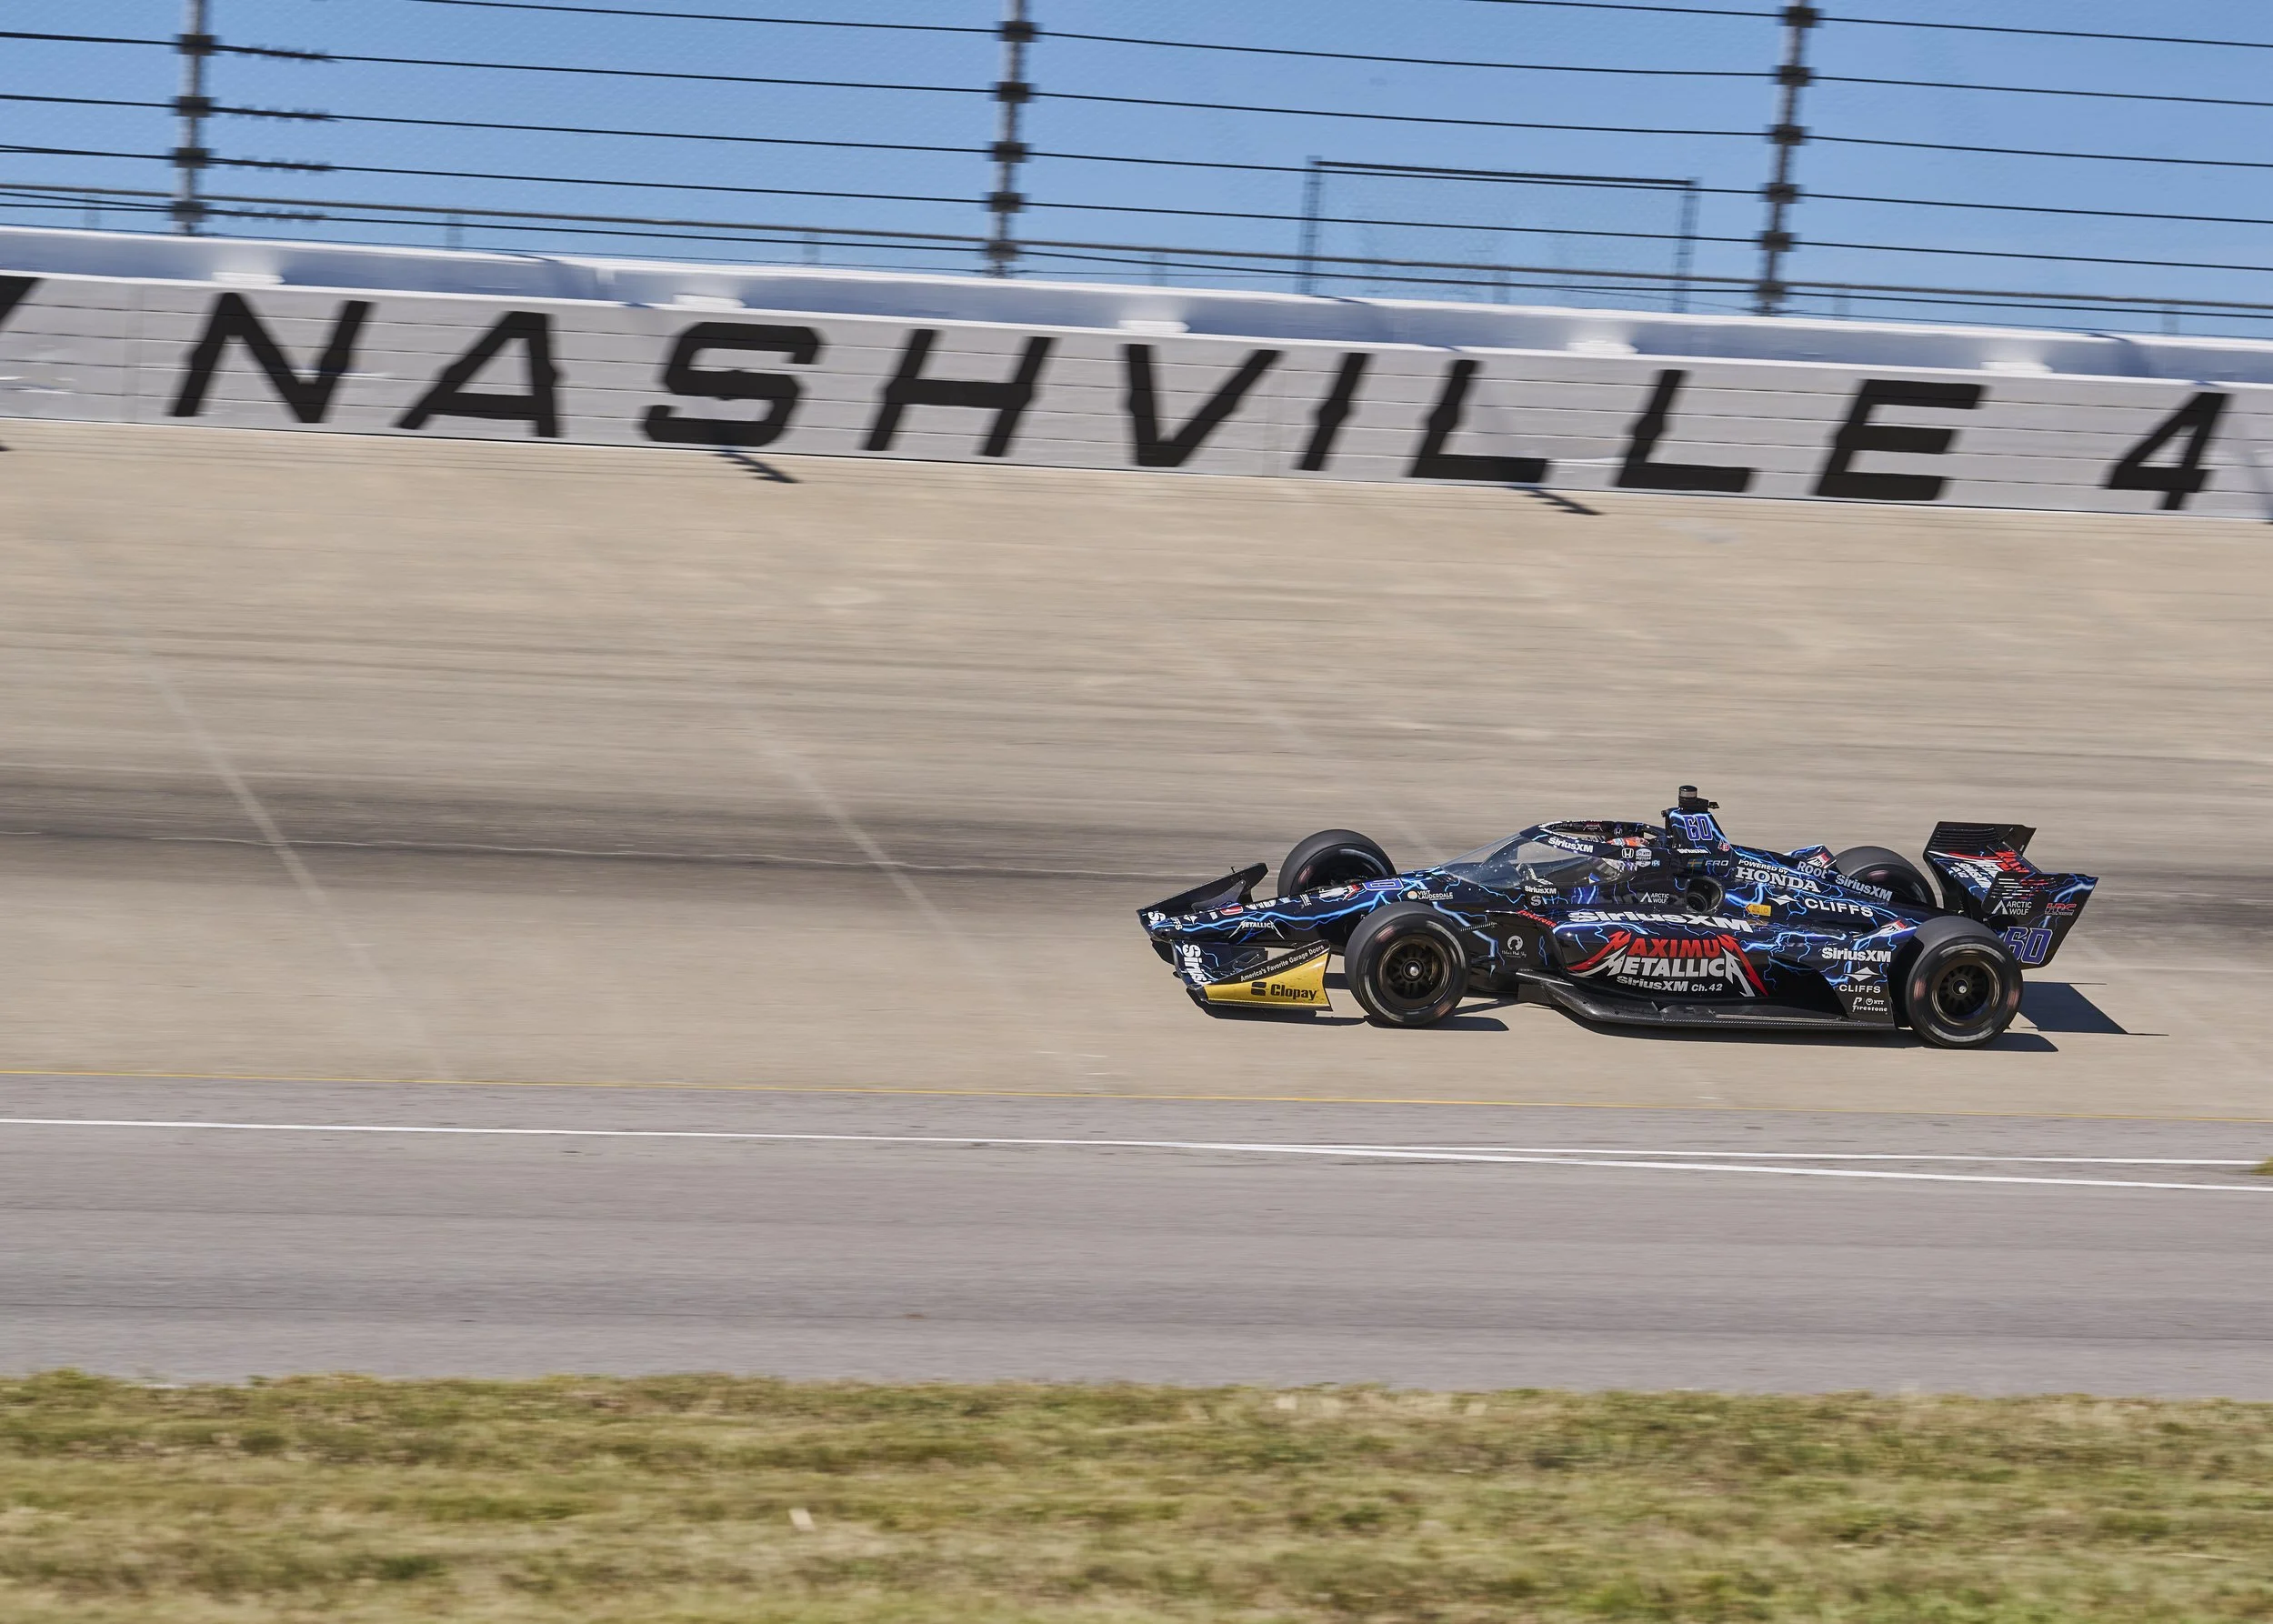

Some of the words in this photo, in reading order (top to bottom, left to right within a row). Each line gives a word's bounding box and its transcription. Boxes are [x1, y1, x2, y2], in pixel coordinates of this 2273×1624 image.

[166, 291, 1991, 501] NASHVILLE
[2098, 391, 2237, 510] 4
[1682, 815, 1713, 840] 60
[1547, 837, 1594, 853] SiriusXM
[1738, 859, 1777, 871] POWERED
[1524, 885, 1557, 894] SiriusXM
[1735, 866, 1821, 893] HONDA
[1835, 874, 1893, 902] SiriusXM
[1417, 891, 1454, 899] LAUDERDALE
[1804, 898, 1874, 917] CLIFFS
[1568, 911, 1754, 933] SiriusXM
[1821, 947, 1892, 962] SiriusXM
[2003, 927, 2053, 965] 60
[1240, 967, 1267, 982] America's
[1267, 959, 1289, 972] Favorite
[1288, 951, 1308, 963] Garage
[1308, 945, 1325, 956] Doors
[1567, 930, 1768, 997] MAXIMUM
[1567, 946, 1756, 997] METALLICA
[1270, 983, 1317, 1000] Clopay
[1616, 976, 1688, 992] SiriusXM
[1838, 984, 1881, 993] CLIFFS
